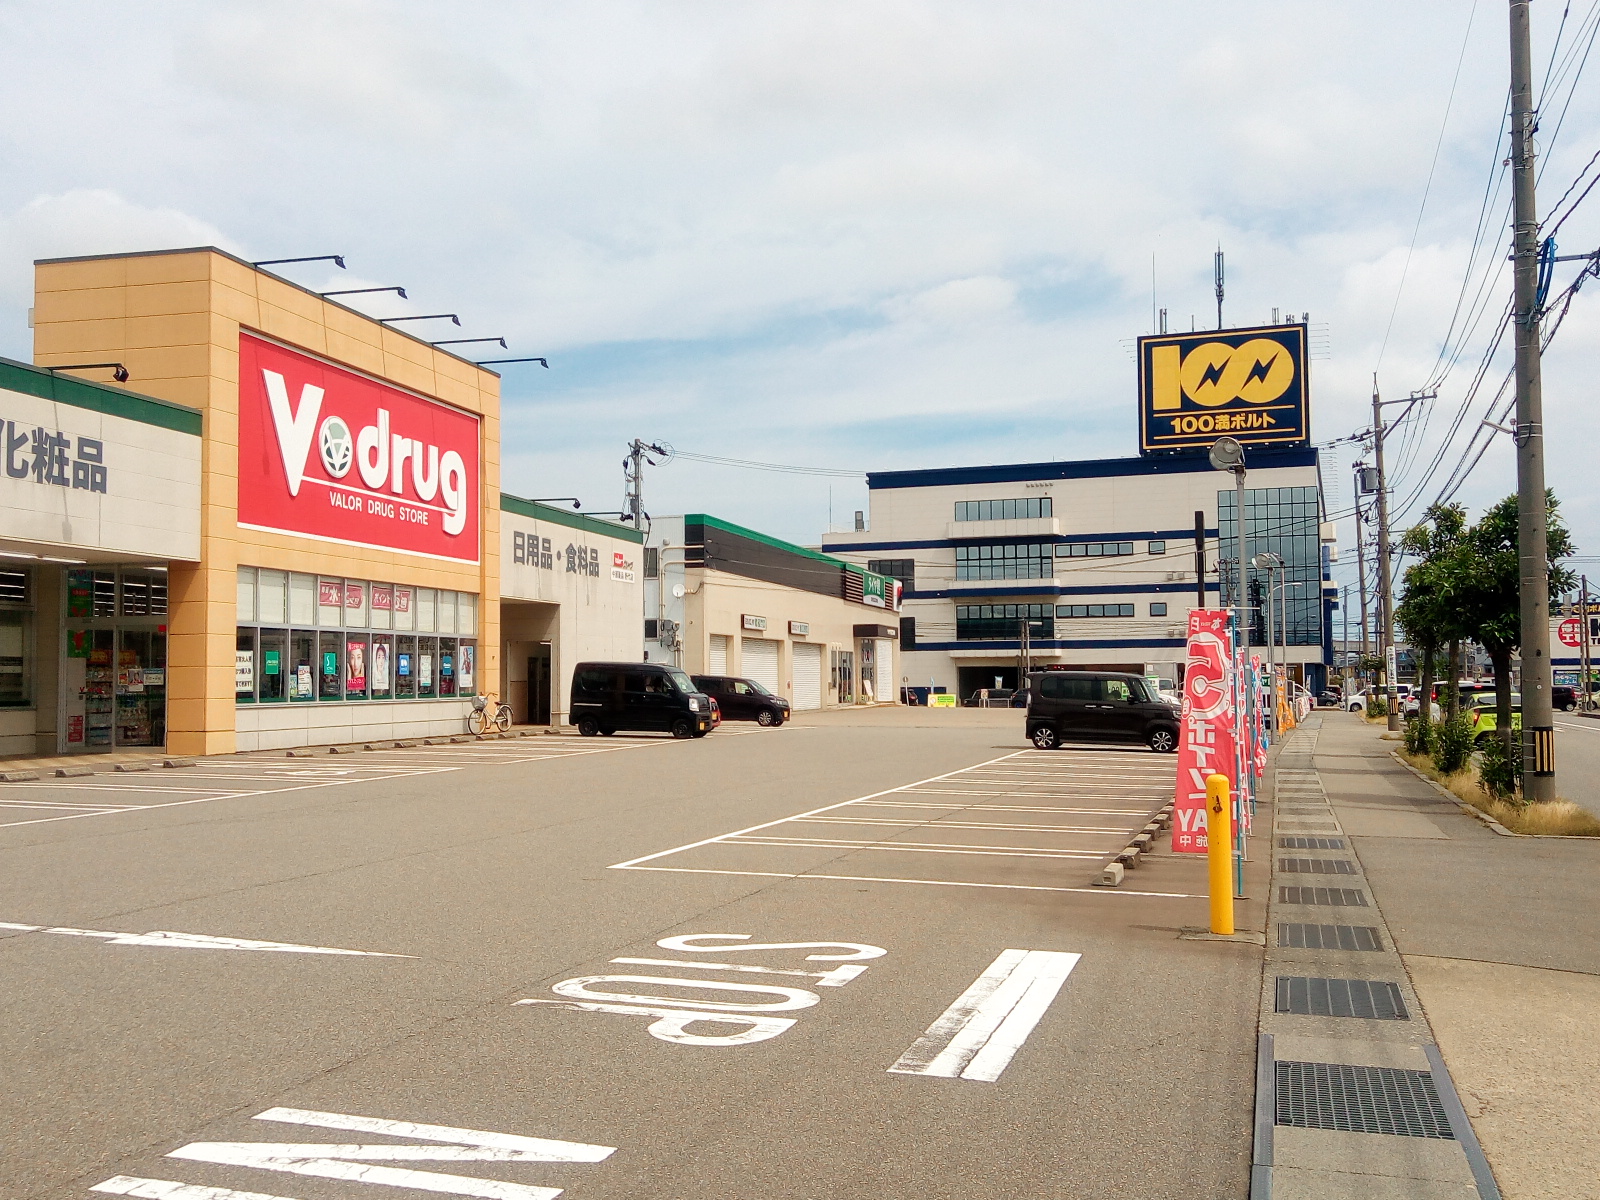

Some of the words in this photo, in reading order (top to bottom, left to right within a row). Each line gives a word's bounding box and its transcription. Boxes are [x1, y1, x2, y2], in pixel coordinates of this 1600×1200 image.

[1152, 338, 1295, 410] 100
[1170, 412, 1276, 434] 100満ボルト
[329, 491, 363, 512] VALOR
[367, 502, 395, 519] DRUG
[399, 507, 429, 525] STORE
[513, 530, 600, 578] 日用品・食料品
[511, 933, 889, 1047] STOP
